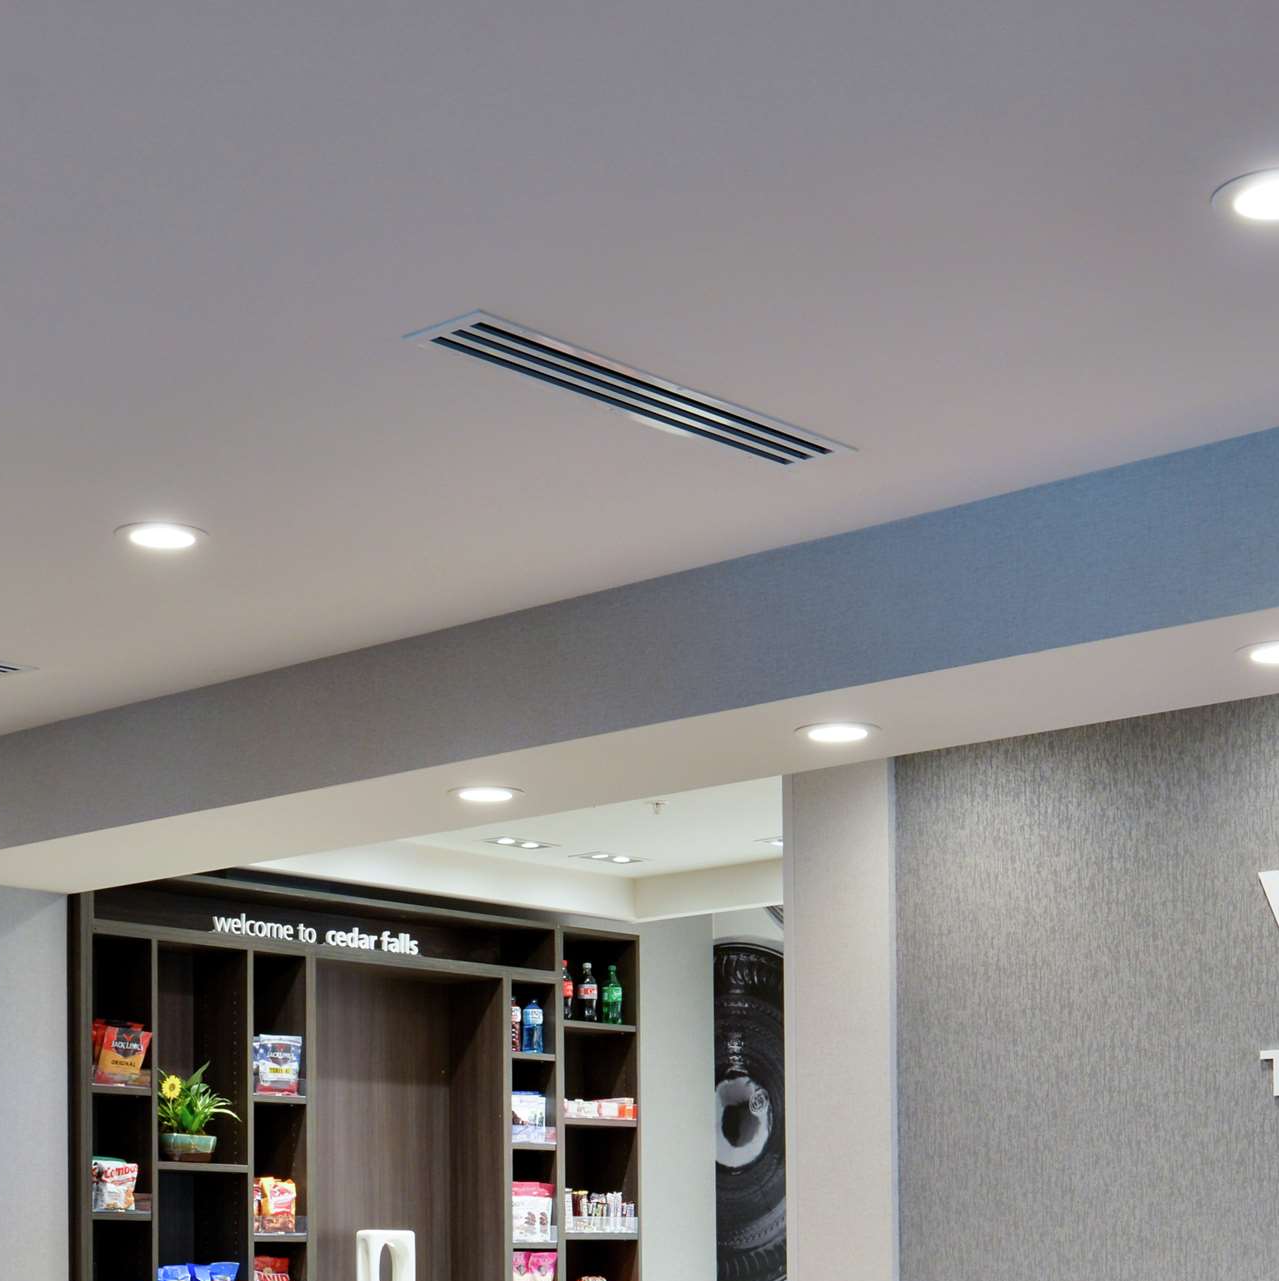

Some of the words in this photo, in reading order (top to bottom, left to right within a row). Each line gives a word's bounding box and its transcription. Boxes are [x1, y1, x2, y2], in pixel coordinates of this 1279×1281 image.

[212, 913, 294, 941] welcome
[297, 923, 318, 944] to
[325, 927, 378, 951] cedar
[380, 931, 419, 956] falls
